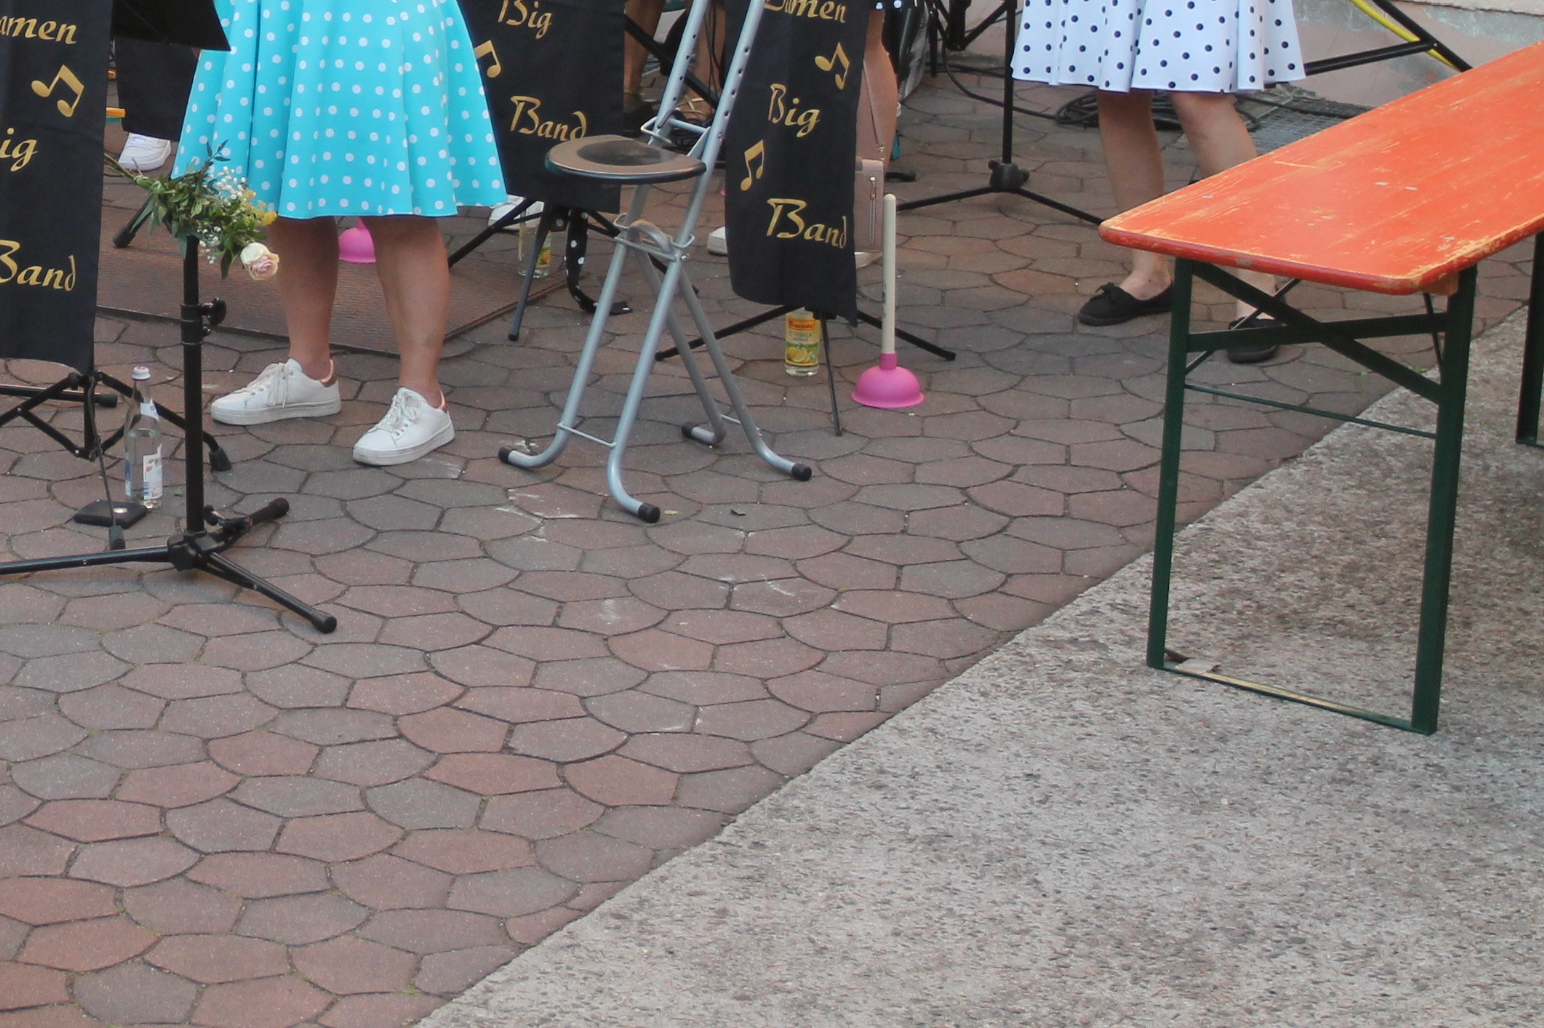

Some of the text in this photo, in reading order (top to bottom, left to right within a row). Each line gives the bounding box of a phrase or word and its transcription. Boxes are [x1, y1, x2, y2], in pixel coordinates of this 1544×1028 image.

[510, 95, 588, 141] Band
[767, 82, 822, 138] Big
[766, 197, 847, 250] Band
